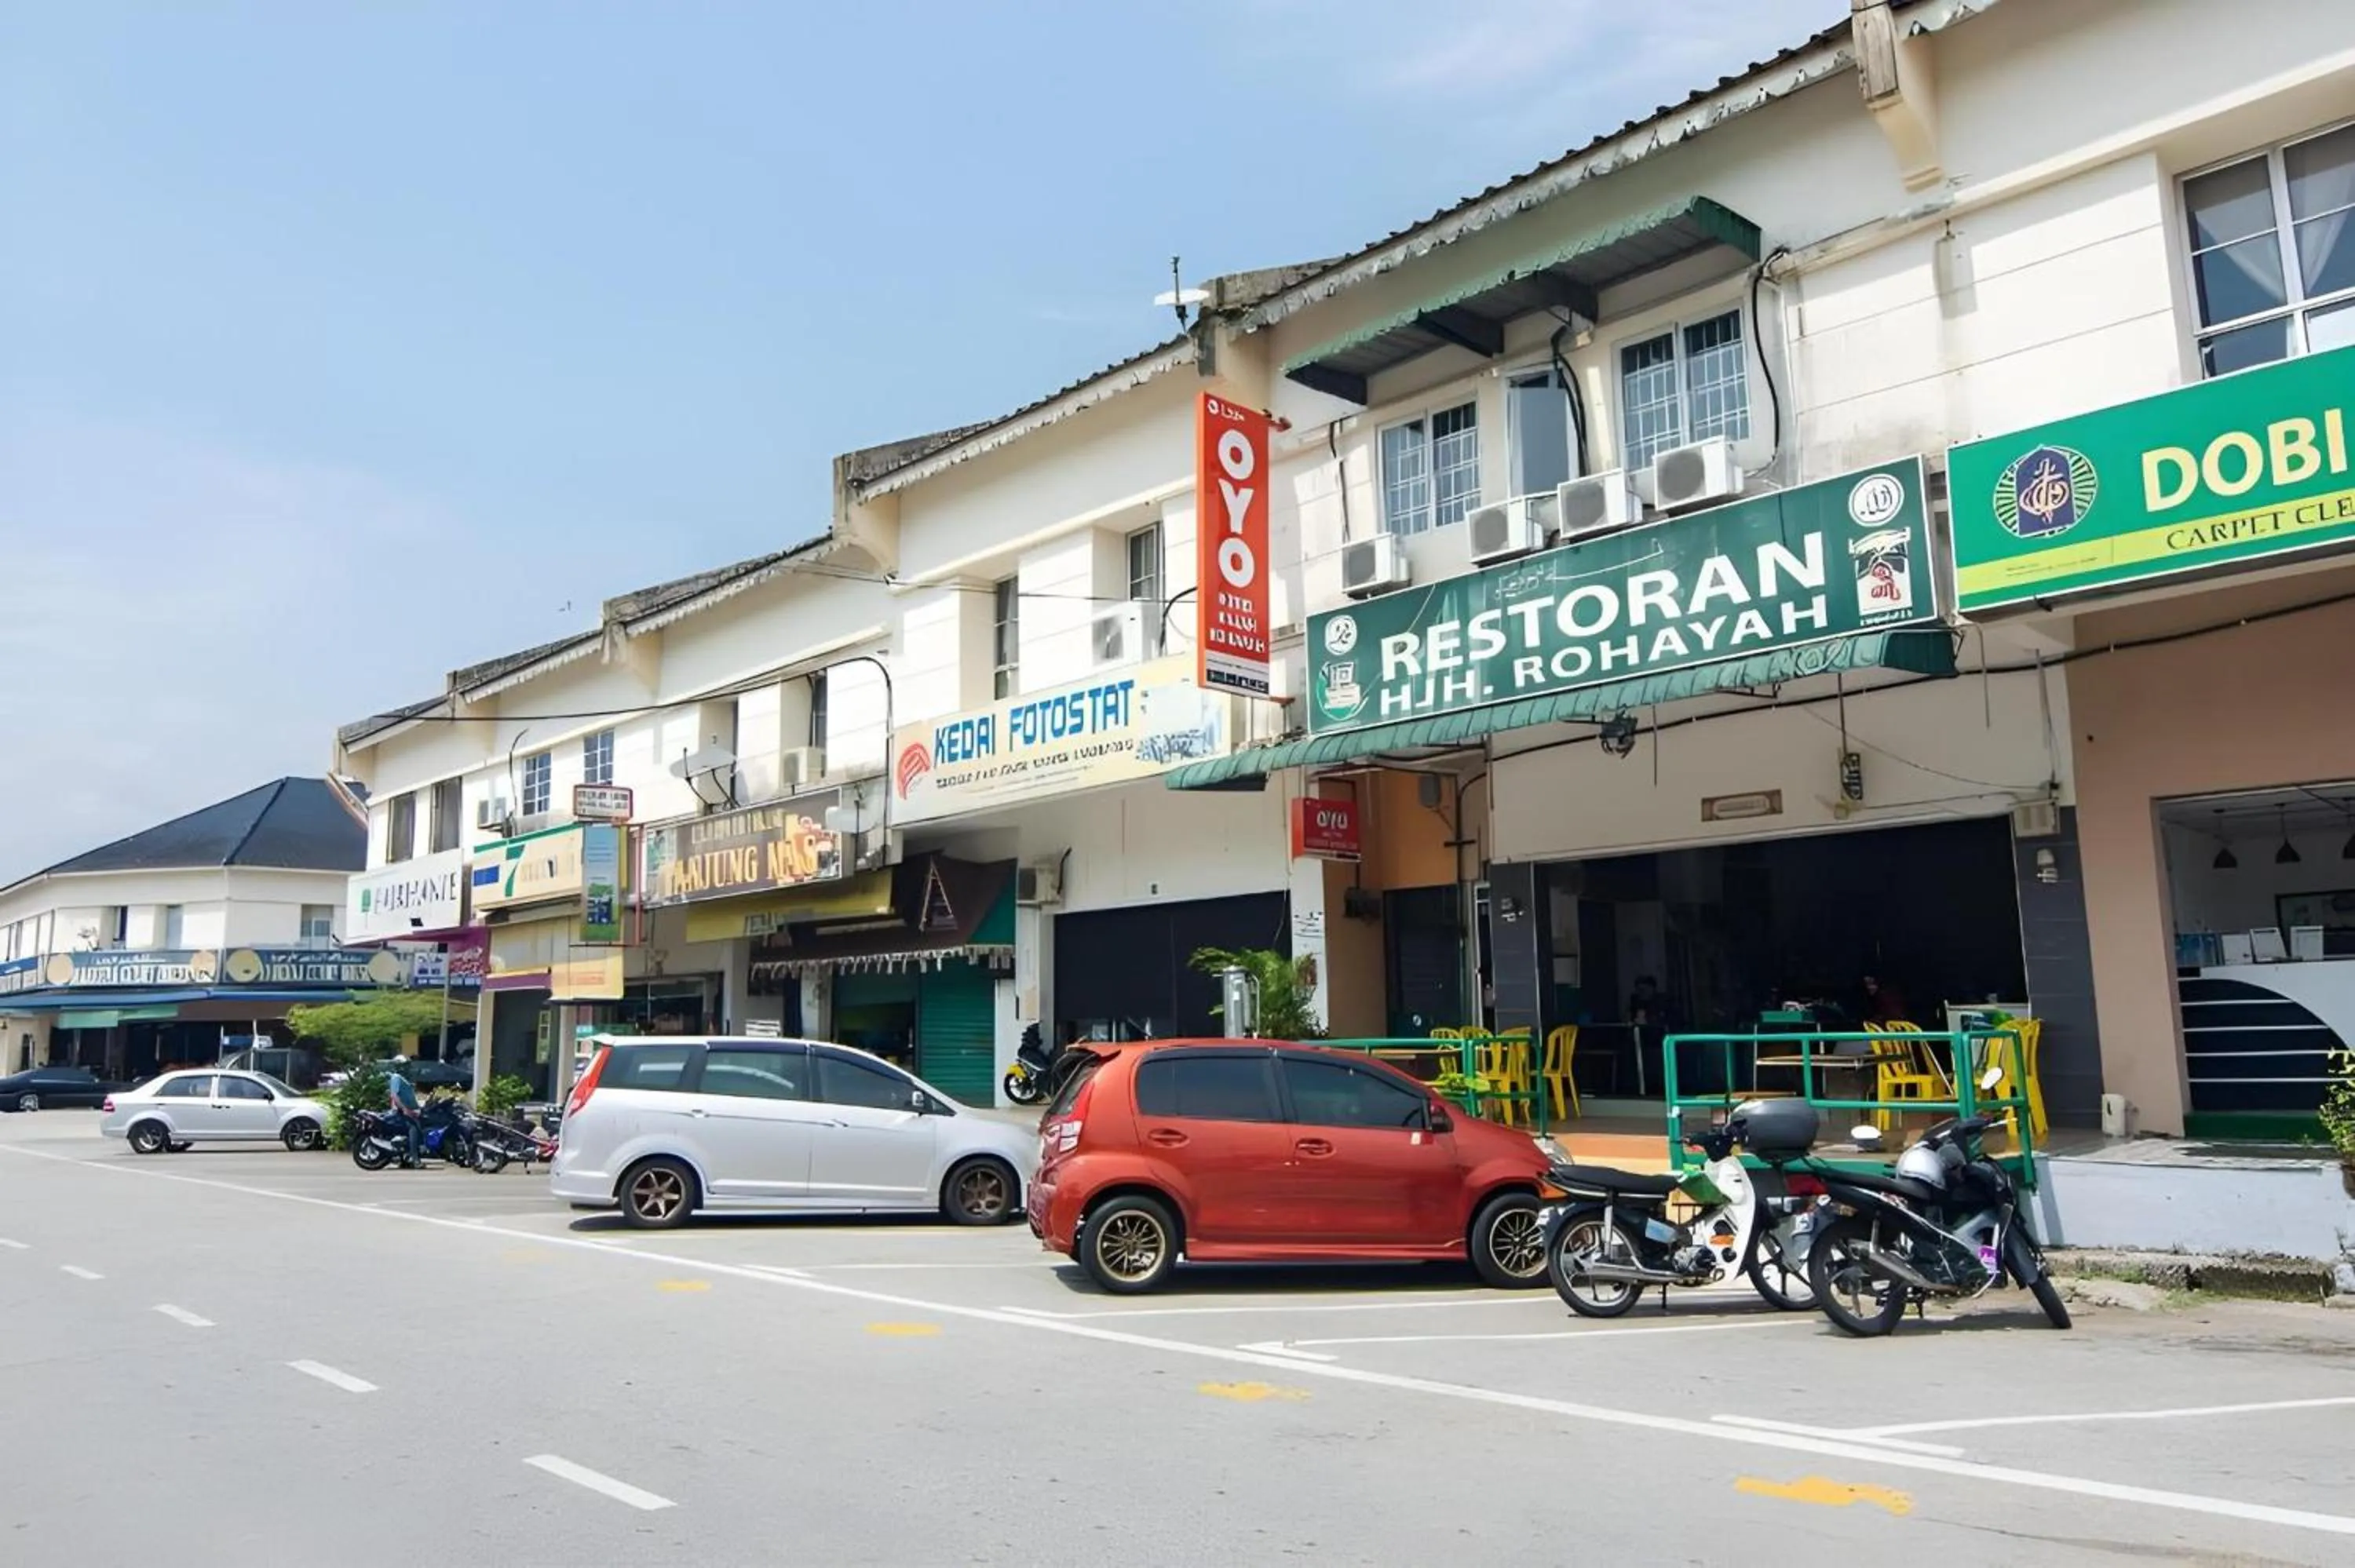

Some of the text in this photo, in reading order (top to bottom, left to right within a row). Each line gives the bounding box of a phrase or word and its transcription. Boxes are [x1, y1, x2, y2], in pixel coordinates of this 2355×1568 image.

[1218, 428, 1254, 589] OYO
[2141, 408, 2348, 512] DOBI
[1380, 532, 1826, 682] RESTORAN
[1381, 593, 1828, 715] HJH. ROHAYAH
[933, 713, 996, 769] KEDAI
[1010, 680, 1134, 752] FOTOSTAT
